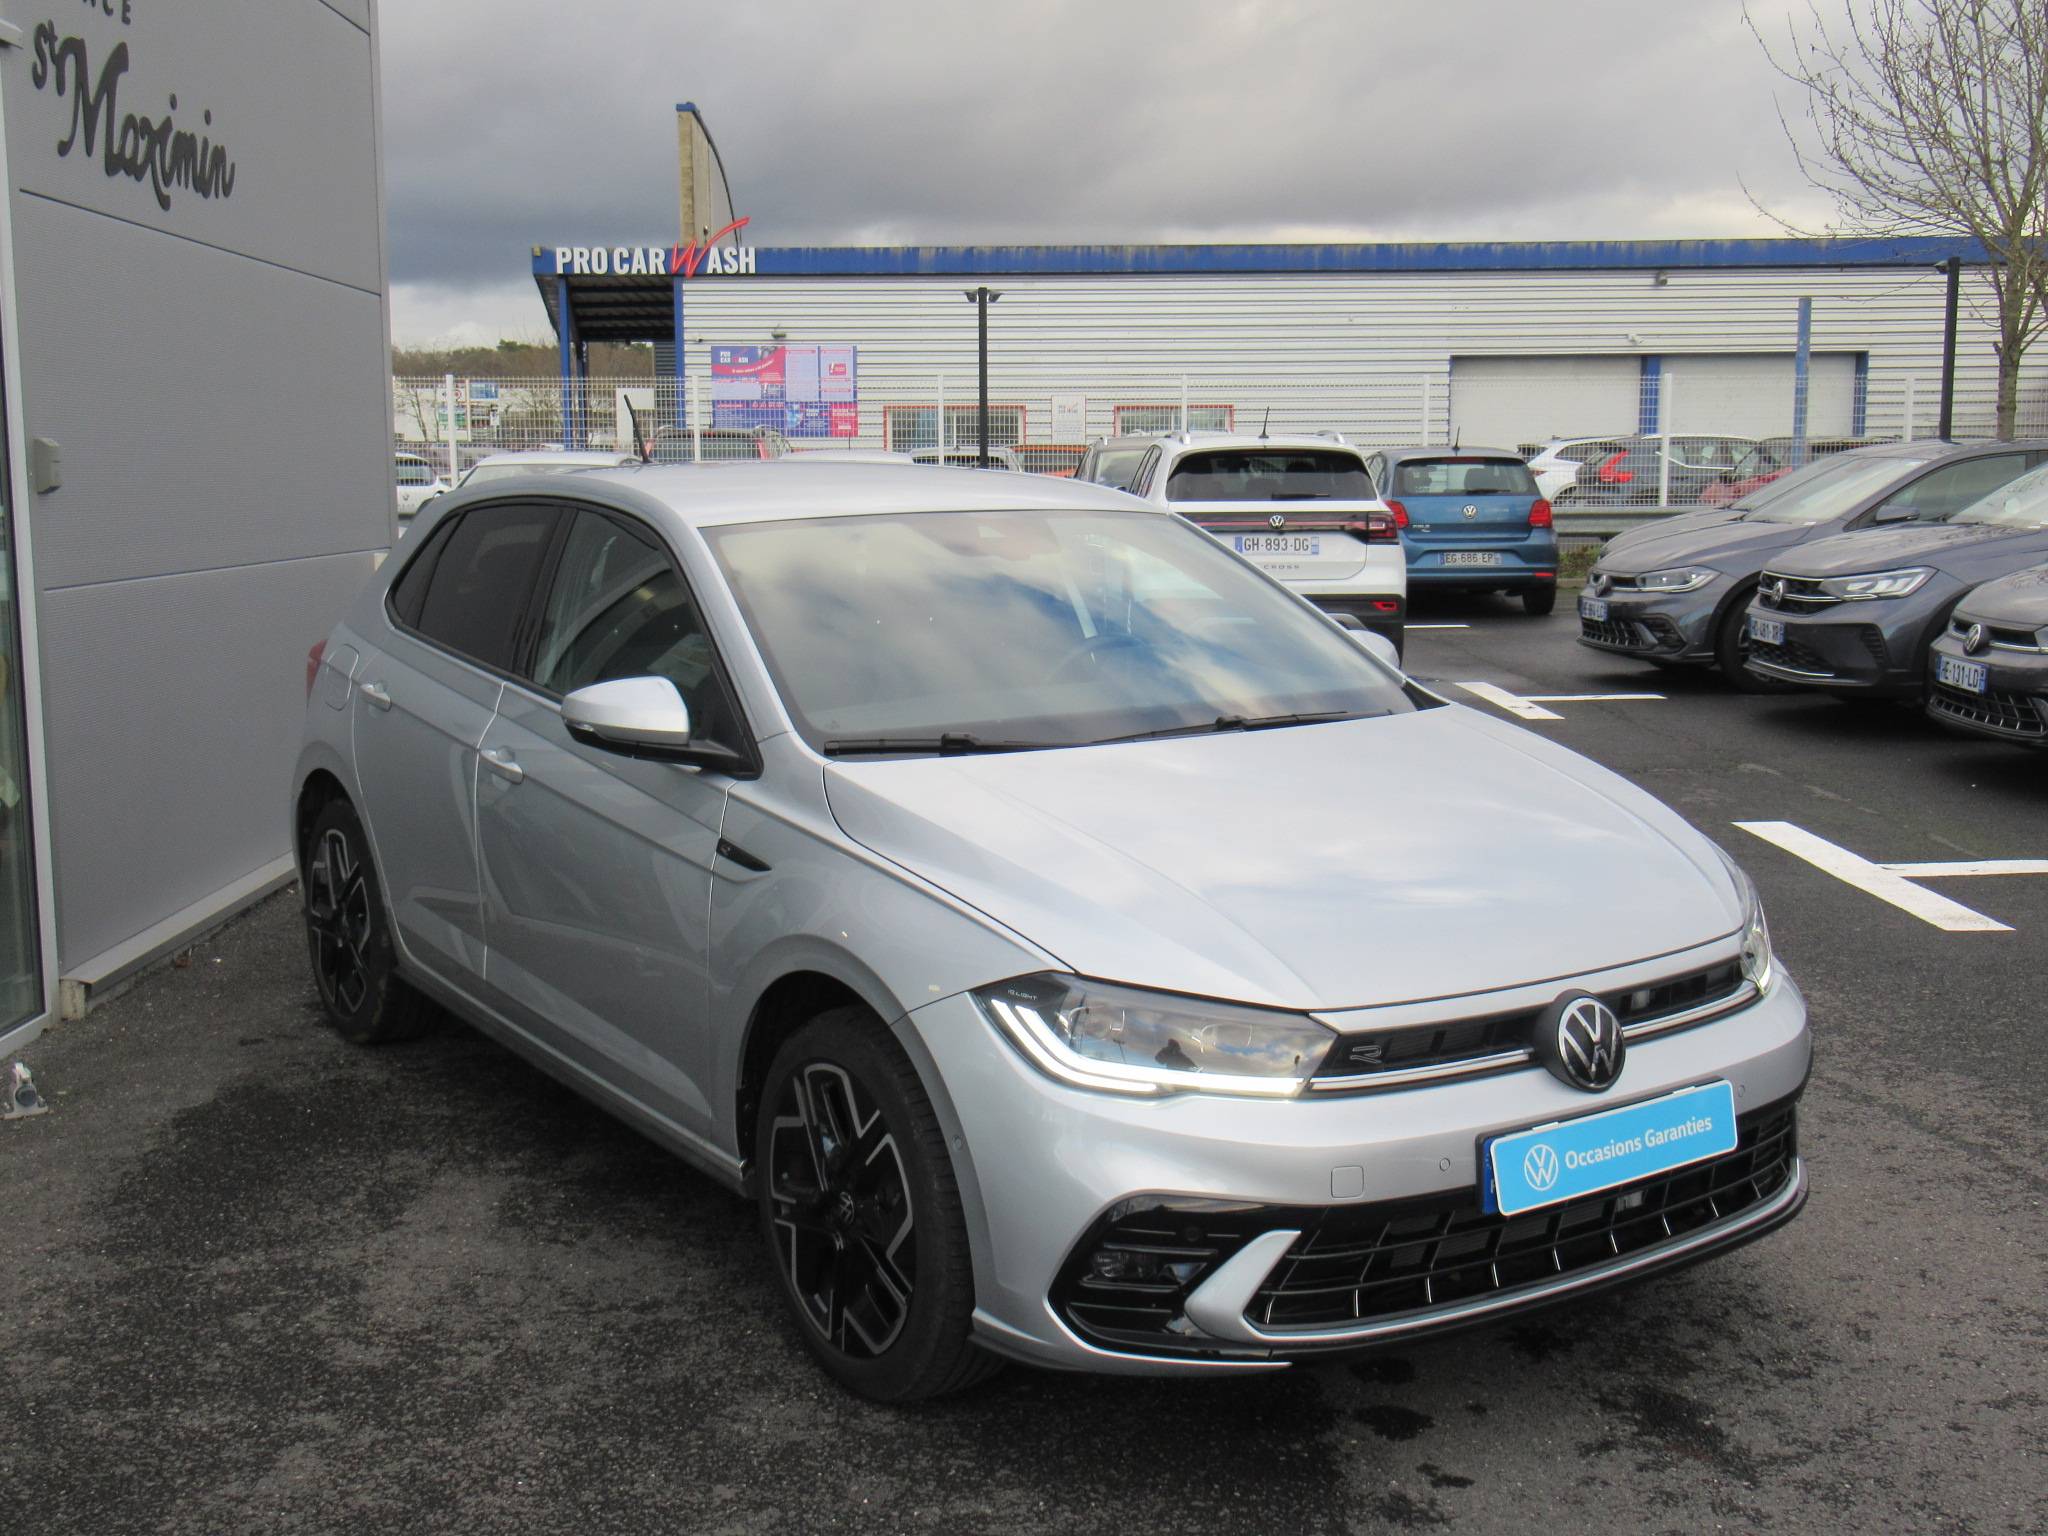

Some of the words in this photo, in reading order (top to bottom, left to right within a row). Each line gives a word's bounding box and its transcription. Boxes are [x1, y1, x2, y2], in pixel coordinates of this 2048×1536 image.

[57, 37, 235, 211] Maximin
[556, 246, 608, 275] PRO
[613, 246, 666, 275] CAR
[671, 215, 757, 279] WASH
[1244, 538, 1309, 551] GH-893-DG
[1564, 1139, 1642, 1170] Occasions
[1644, 1116, 1712, 1148] Garanties
